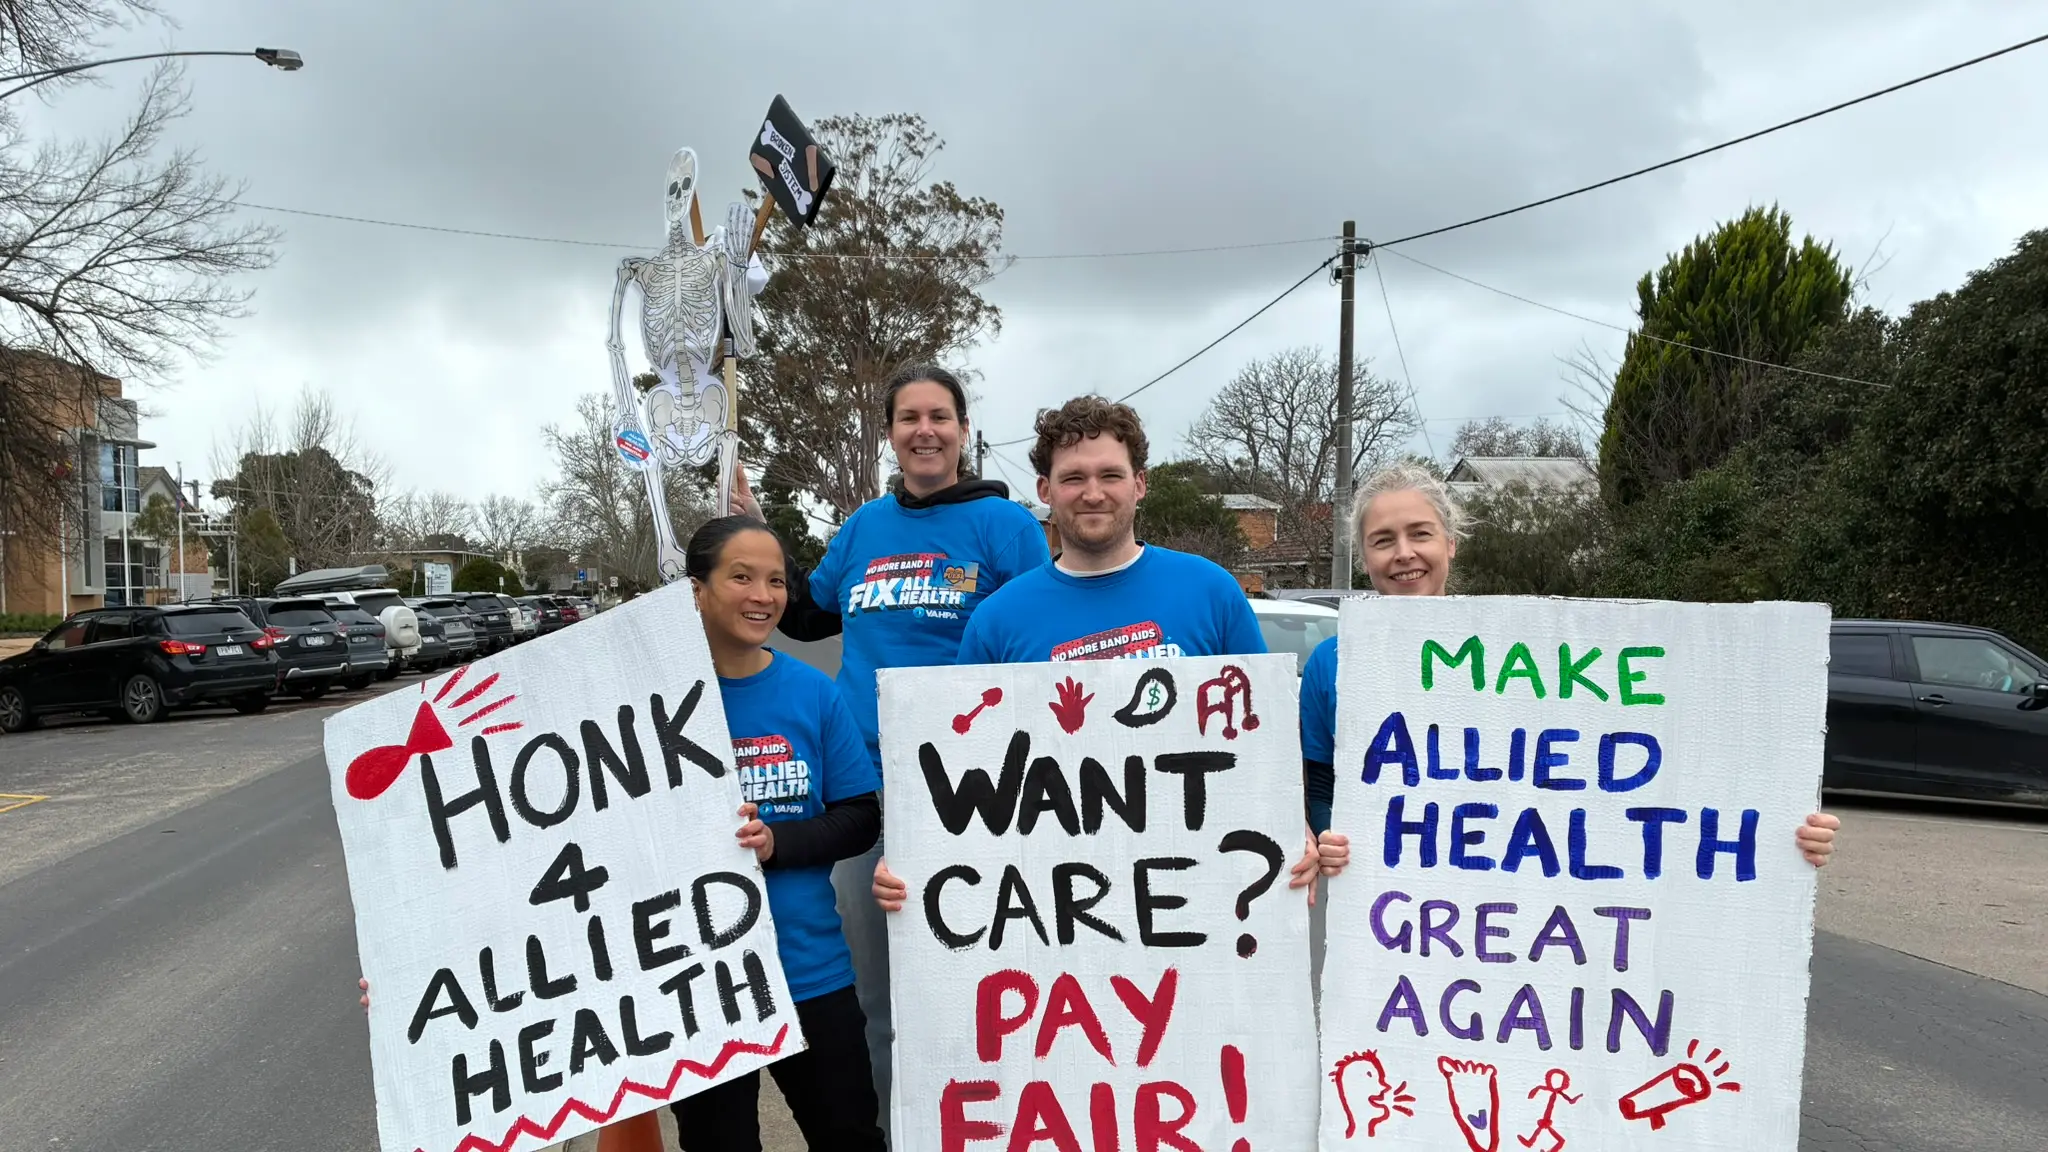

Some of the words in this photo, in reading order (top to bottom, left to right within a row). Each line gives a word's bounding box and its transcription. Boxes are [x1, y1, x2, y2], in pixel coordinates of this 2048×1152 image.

[770, 131, 794, 158] BROKEN
[780, 161, 803, 201] SYSTEM
[848, 577, 904, 613] FIX
[866, 566, 878, 575] NO
[877, 561, 899, 572] MORE
[900, 559, 923, 570] BAND
[898, 589, 962, 606] HEALTH
[926, 609, 959, 620] VAHPA
[1052, 654, 1067, 662] NO
[1068, 643, 1099, 659] MORE
[1100, 634, 1129, 650] BAND
[1131, 628, 1156, 642] AIDS
[1420, 635, 1667, 706] MAKE
[419, 679, 727, 871] HONK
[740, 760, 809, 786] ALLIED
[762, 743, 787, 755] AIDS
[918, 728, 1238, 837] WANT
[1360, 711, 1663, 793] ALLIED
[741, 778, 809, 801] HEALTH
[773, 804, 804, 814] VAHPA
[1383, 795, 1761, 882] HEALTH
[529, 842, 610, 913] 4
[923, 829, 1286, 960] CARE?
[407, 871, 763, 1045] ALLIED
[1369, 890, 1653, 972] GREAT
[452, 948, 777, 1127] HEALTH
[975, 963, 1181, 1069] PAY
[1376, 975, 1675, 1057] AGAIN
[939, 1044, 1252, 1152] FAIR!
